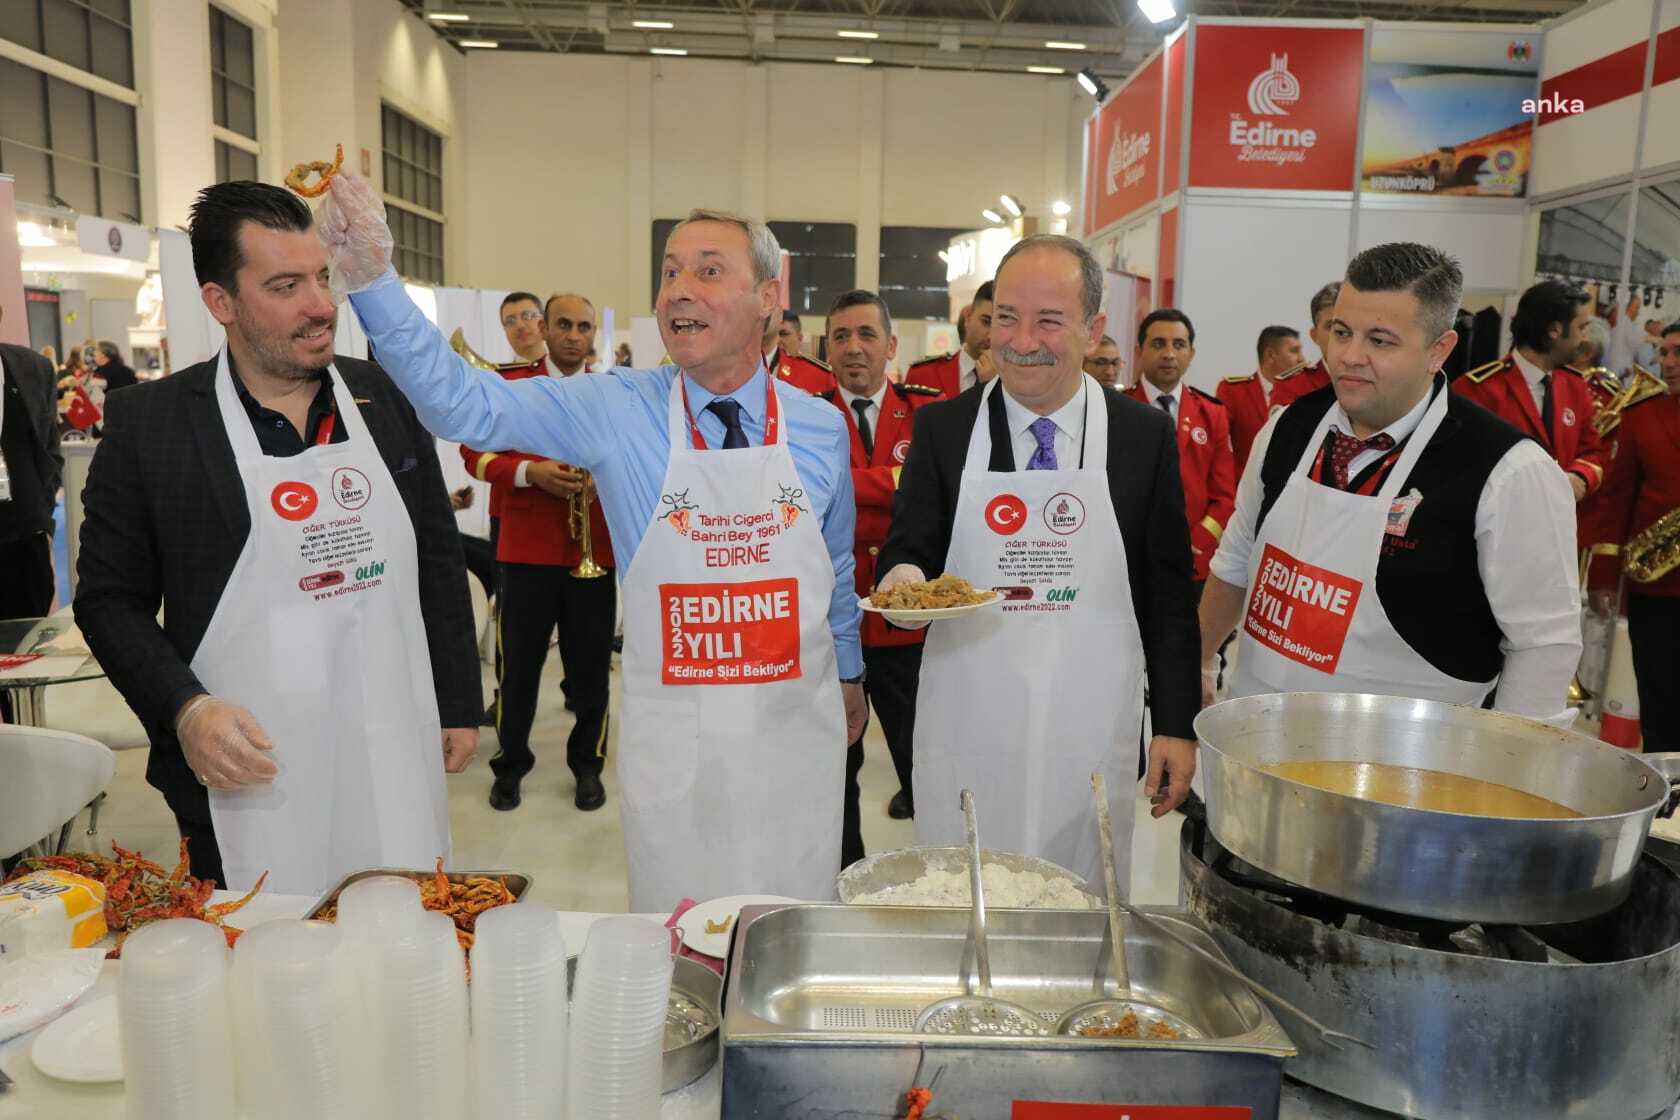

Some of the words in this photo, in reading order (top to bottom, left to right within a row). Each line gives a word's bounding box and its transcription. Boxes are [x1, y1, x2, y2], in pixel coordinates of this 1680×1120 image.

[1229, 120, 1317, 147] Edirne
[698, 514, 730, 526] Tarihi
[691, 530, 727, 542] Bahri
[728, 530, 753, 543] Bey
[756, 524, 781, 538] 1961
[1046, 586, 1077, 602] OLİN
[1268, 561, 1352, 616] EDİRNE
[683, 589, 790, 624] EDİRNE
[1260, 591, 1294, 630] YILI
[684, 632, 743, 660] YILI
[1267, 629, 1284, 646] Sizi
[717, 664, 740, 677] Sizi
